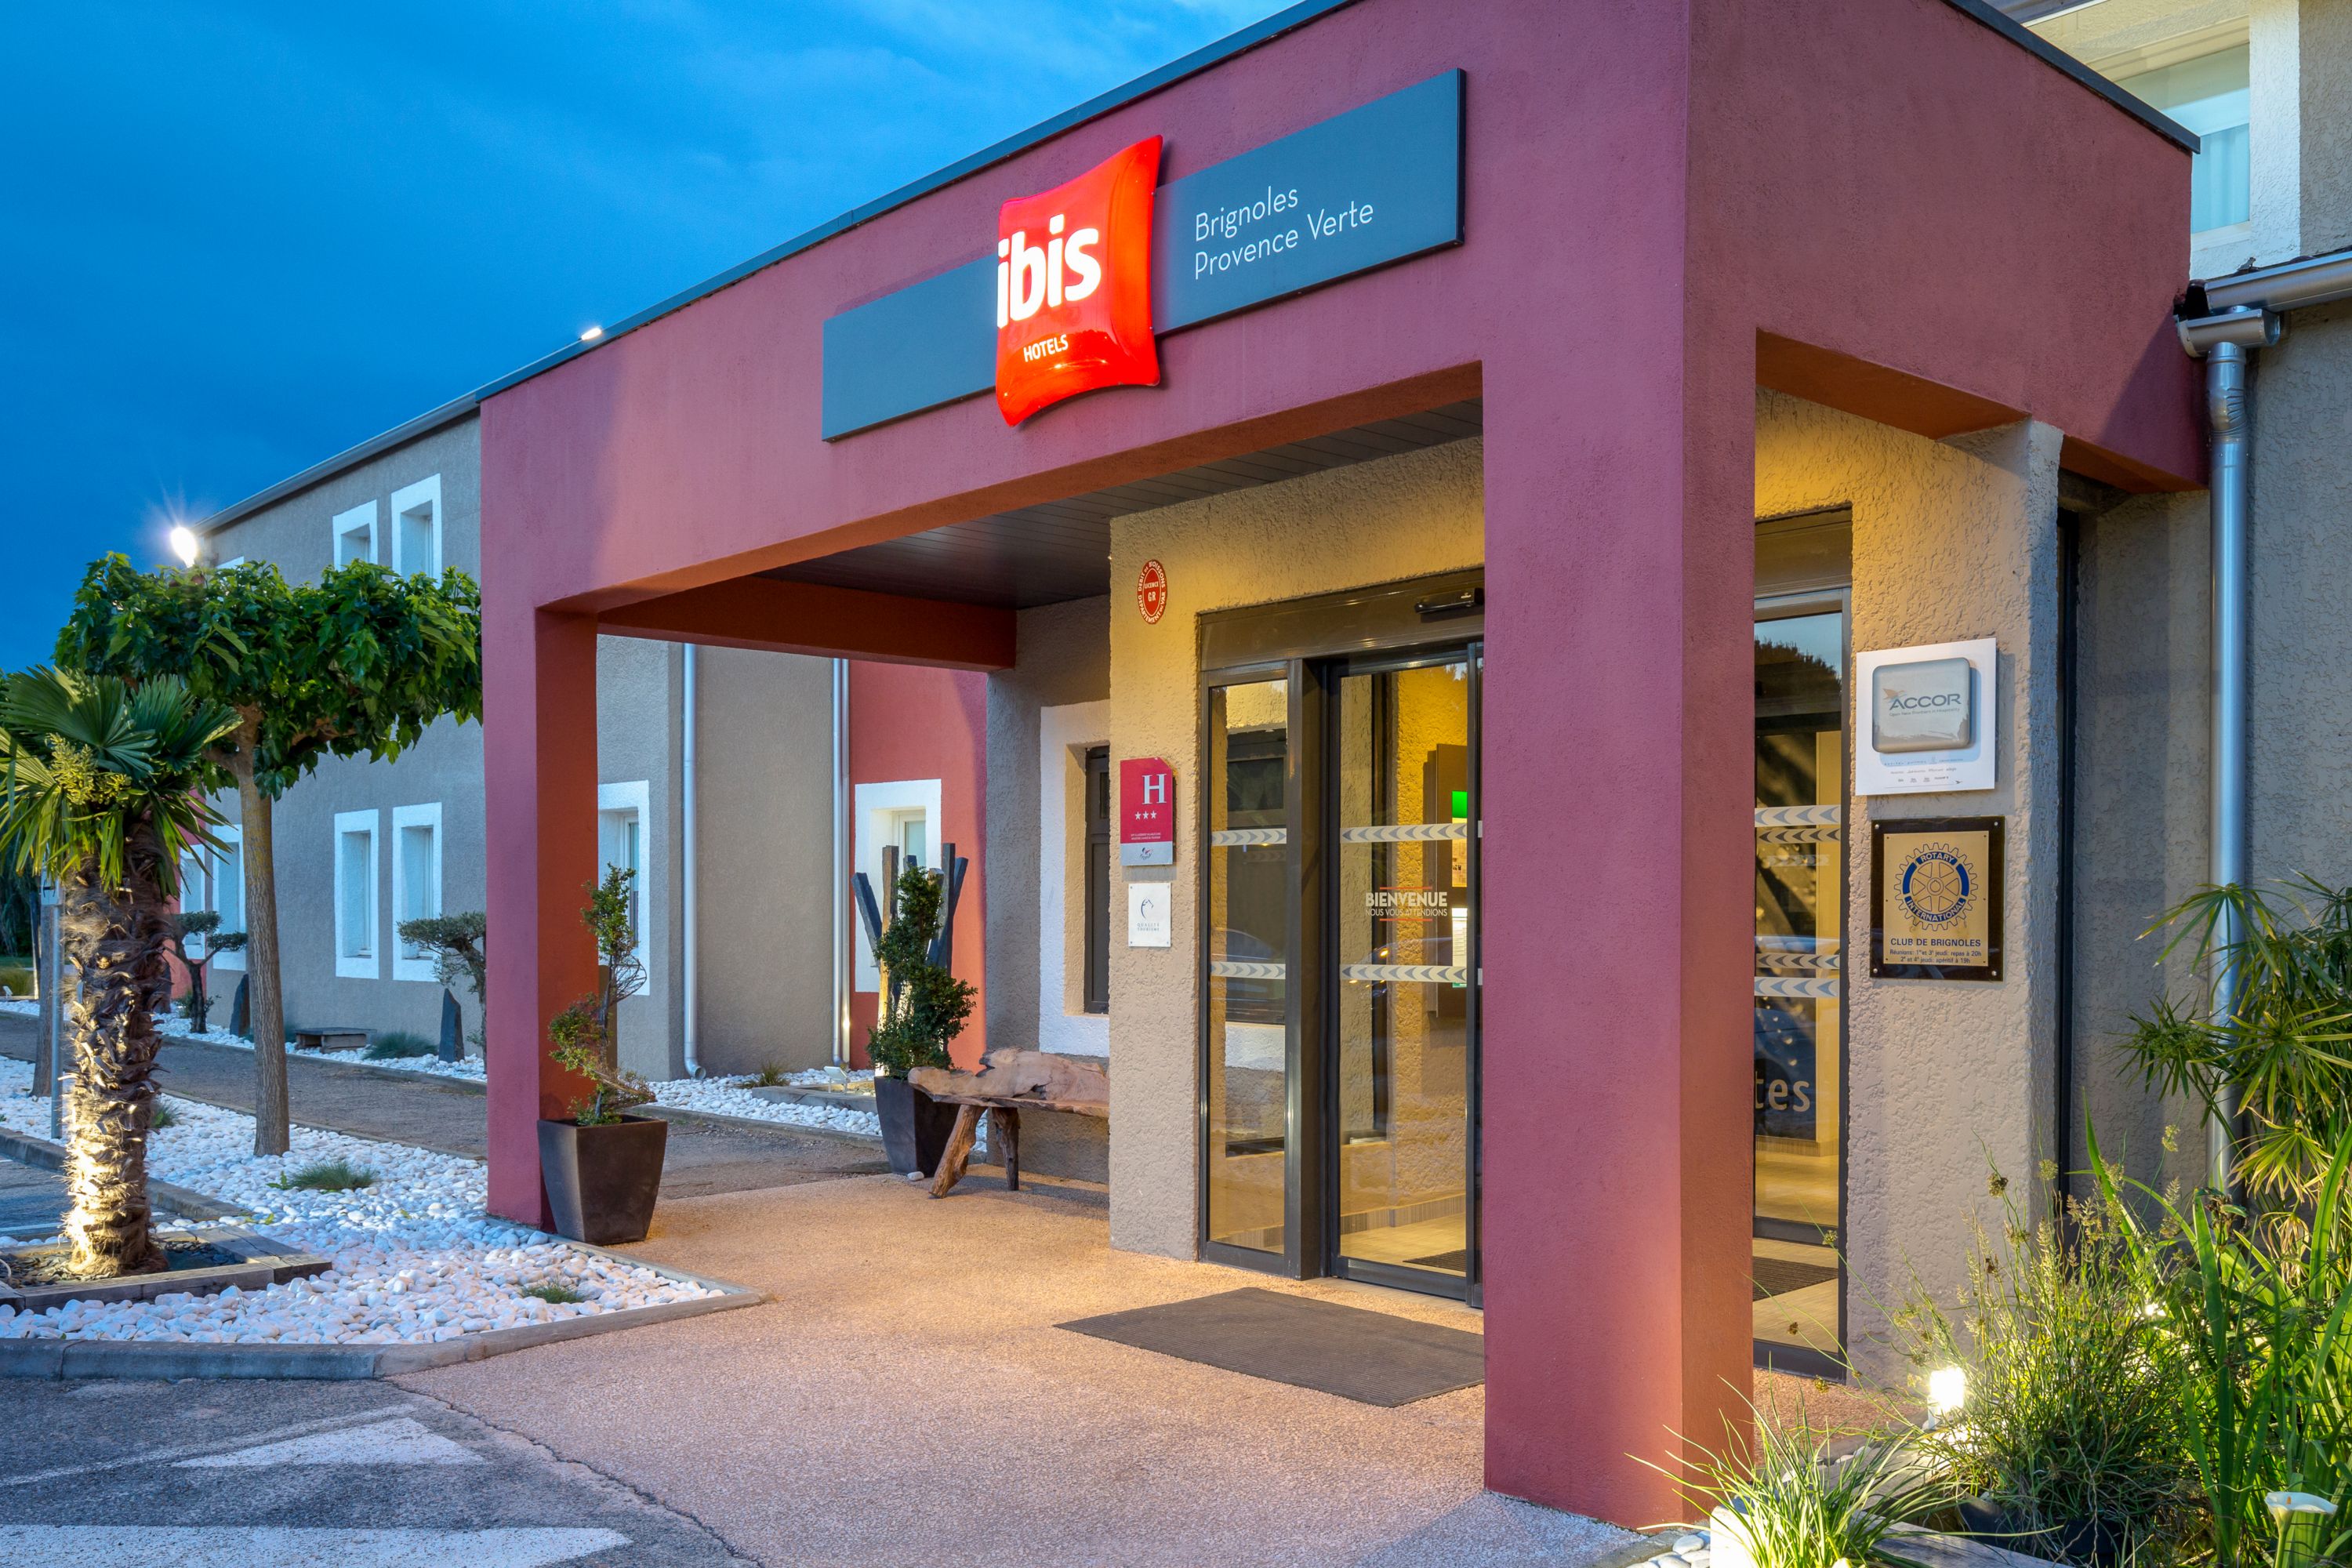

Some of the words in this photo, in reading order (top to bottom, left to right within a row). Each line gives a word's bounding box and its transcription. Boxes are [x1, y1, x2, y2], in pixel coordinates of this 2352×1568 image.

[1196, 185, 1298, 241] Brignoles
[1196, 229, 1298, 280] Provence
[1307, 201, 1374, 241] Verte
[997, 214, 1102, 329] ibis
[1023, 334, 1069, 362] HOTELS
[1148, 591, 1156, 602] GR
[1889, 694, 1962, 710] ACCOR
[1142, 774, 1167, 804] H
[1921, 852, 1955, 862] ROTARY
[1366, 891, 1447, 907] BIENVENUE
[1907, 899, 1965, 922] INTERNATIONAL
